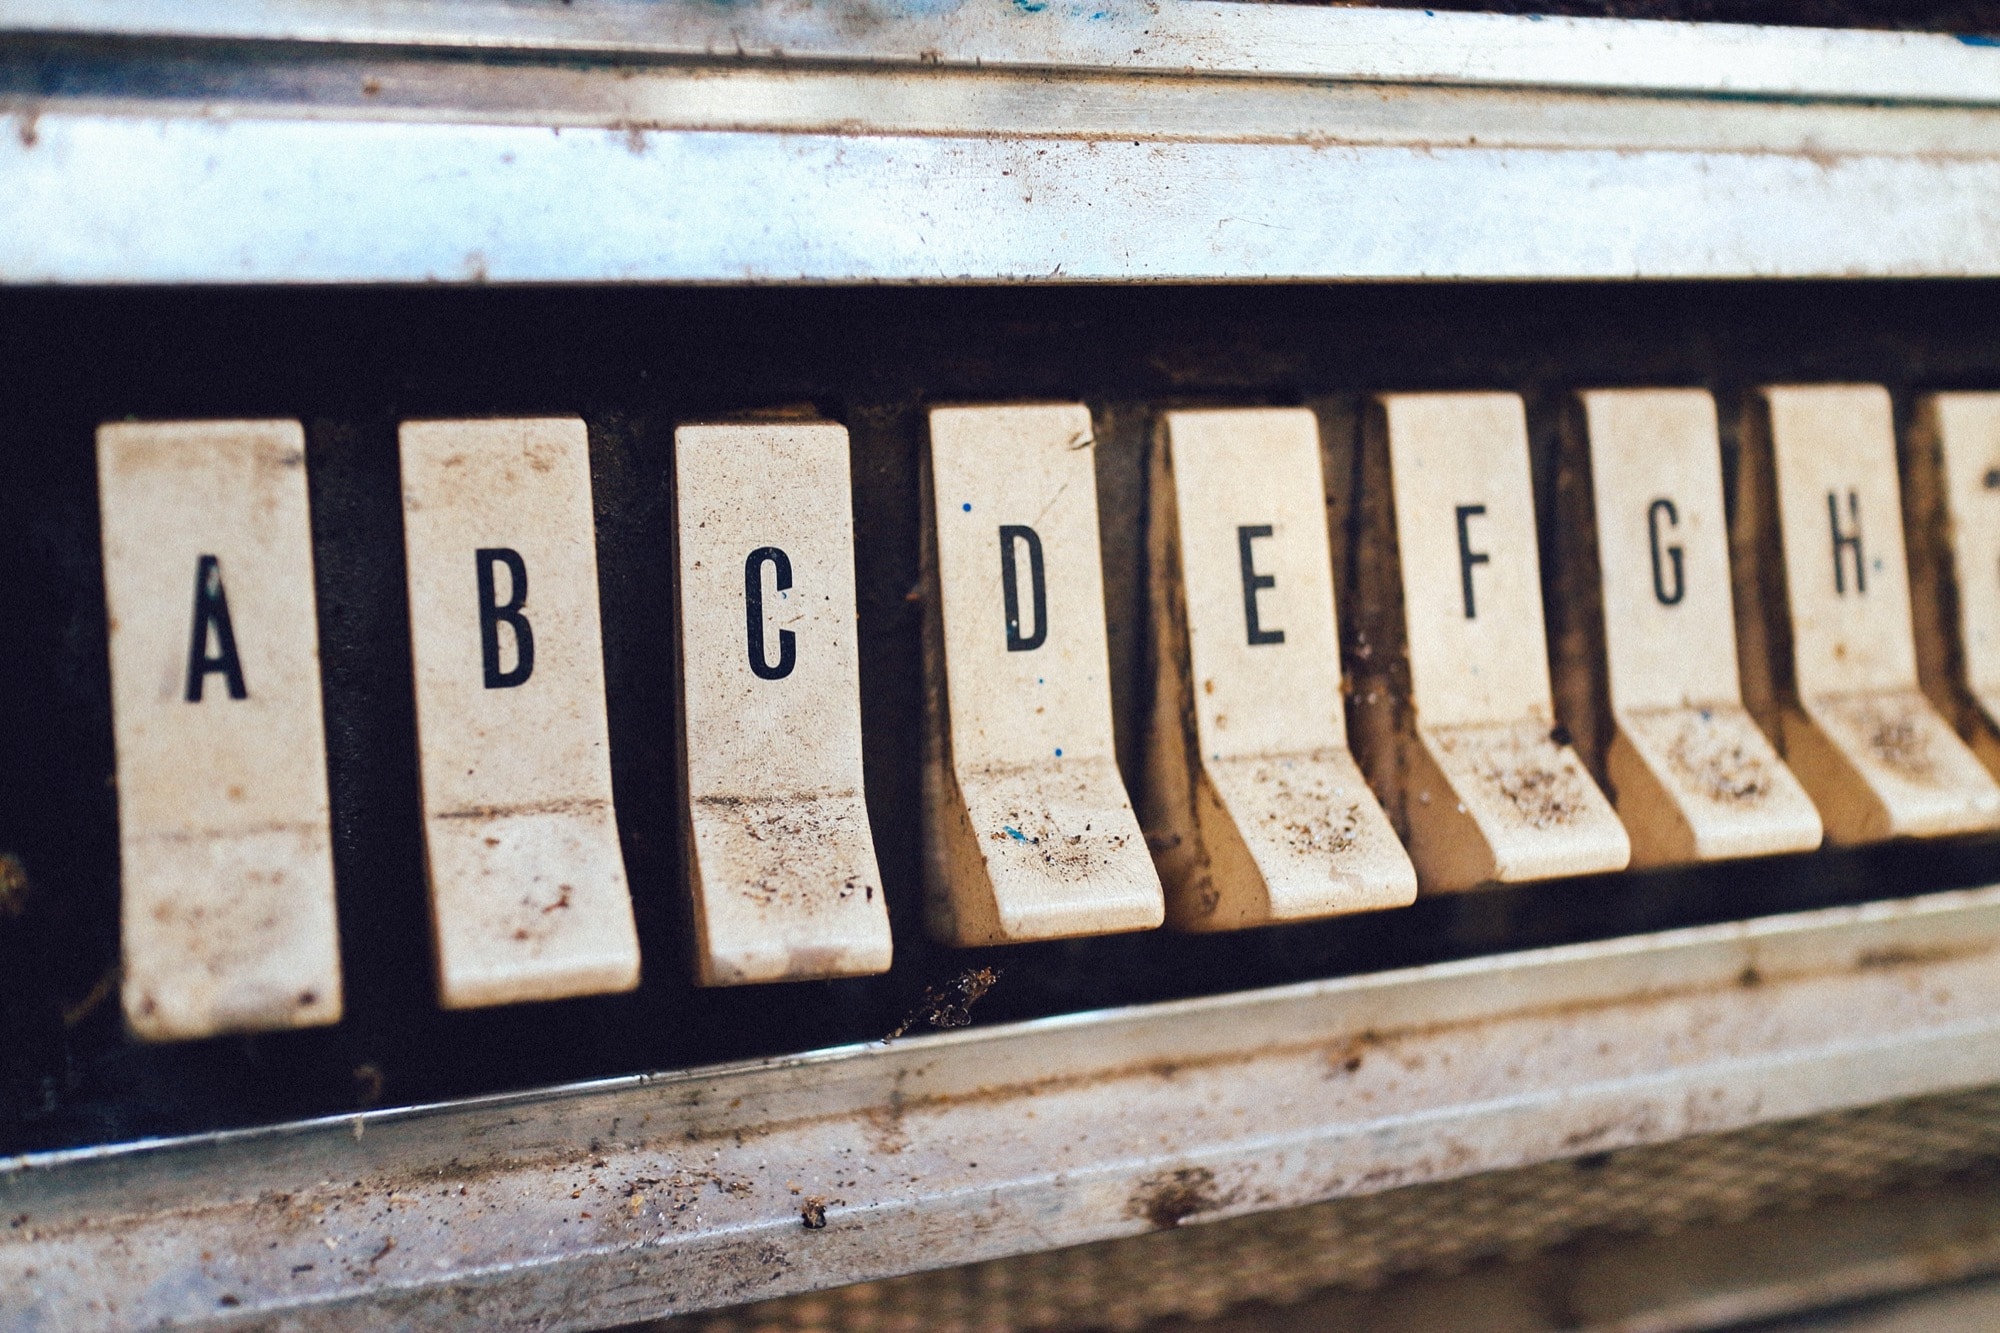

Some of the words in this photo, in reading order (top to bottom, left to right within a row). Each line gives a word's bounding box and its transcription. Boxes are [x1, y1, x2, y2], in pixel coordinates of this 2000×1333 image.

[999, 524, 1048, 652] D
[1238, 524, 1285, 646] E
[1455, 504, 1491, 620] F
[1646, 498, 1686, 607] G
[1827, 489, 1867, 597] H
[186, 554, 247, 702] A
[475, 547, 534, 690] B
[744, 546, 797, 681] C
